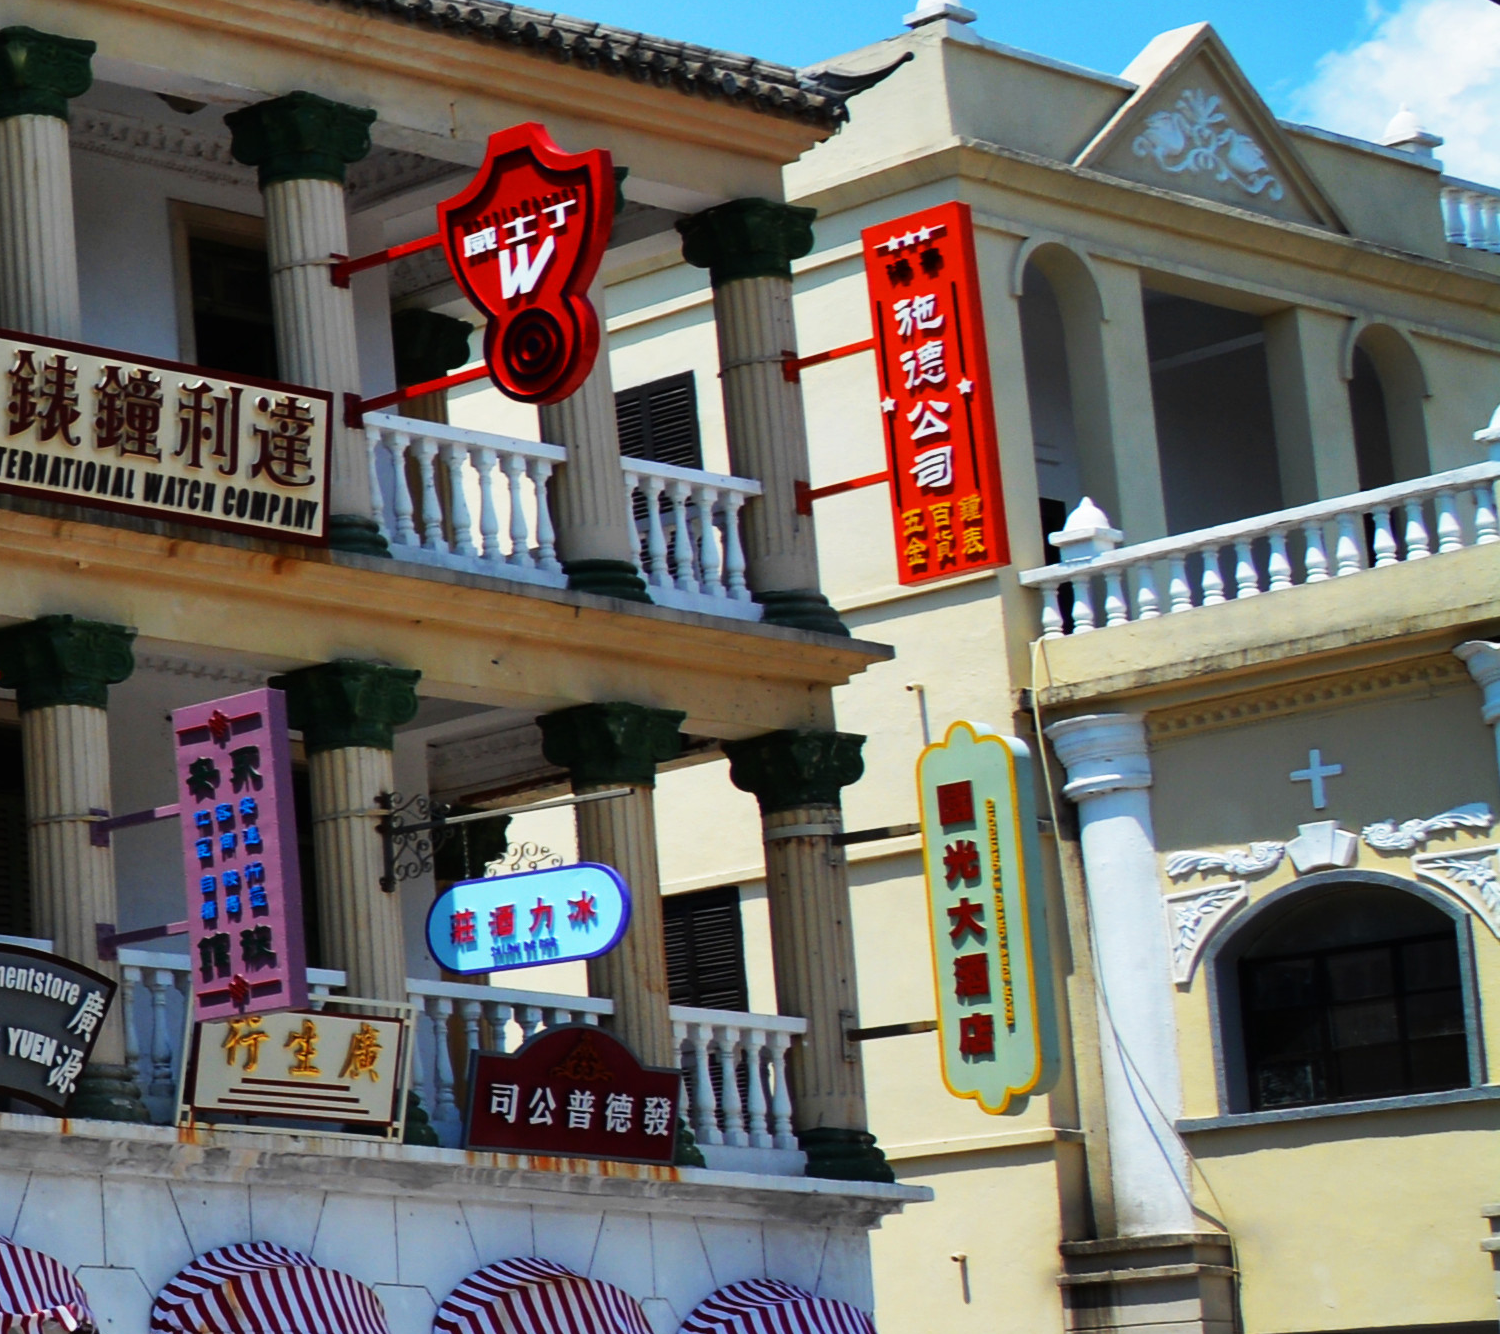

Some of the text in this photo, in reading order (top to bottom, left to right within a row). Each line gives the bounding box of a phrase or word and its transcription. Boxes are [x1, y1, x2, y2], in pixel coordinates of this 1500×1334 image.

[463, 199, 577, 258] 威士丁
[498, 234, 556, 300] W
[893, 293, 954, 489] 施德公司
[143, 473, 216, 513] WATCH
[222, 485, 319, 530] COMPANY
[8, 1027, 58, 1067] YUEN
